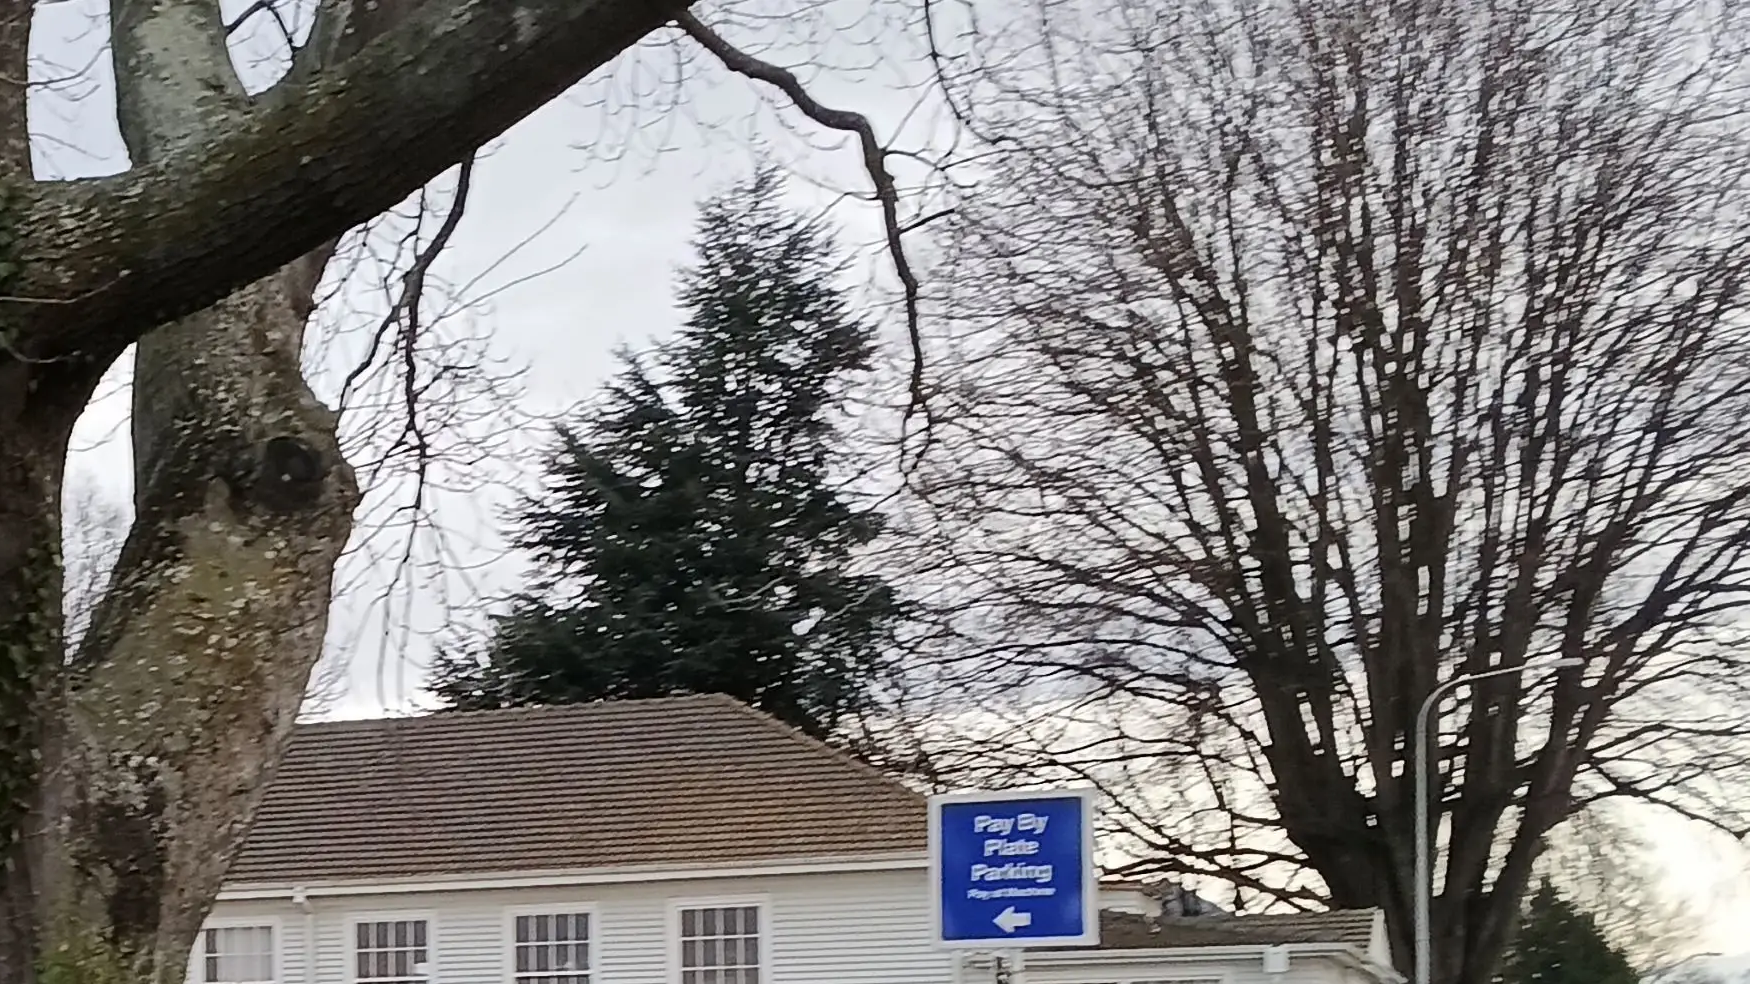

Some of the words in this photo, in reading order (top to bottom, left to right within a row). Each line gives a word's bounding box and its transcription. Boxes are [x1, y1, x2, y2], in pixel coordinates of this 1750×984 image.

[974, 815, 1014, 835] Pay
[1017, 813, 1049, 834] By
[983, 839, 1040, 857] Plate
[970, 862, 1052, 883] Parking
